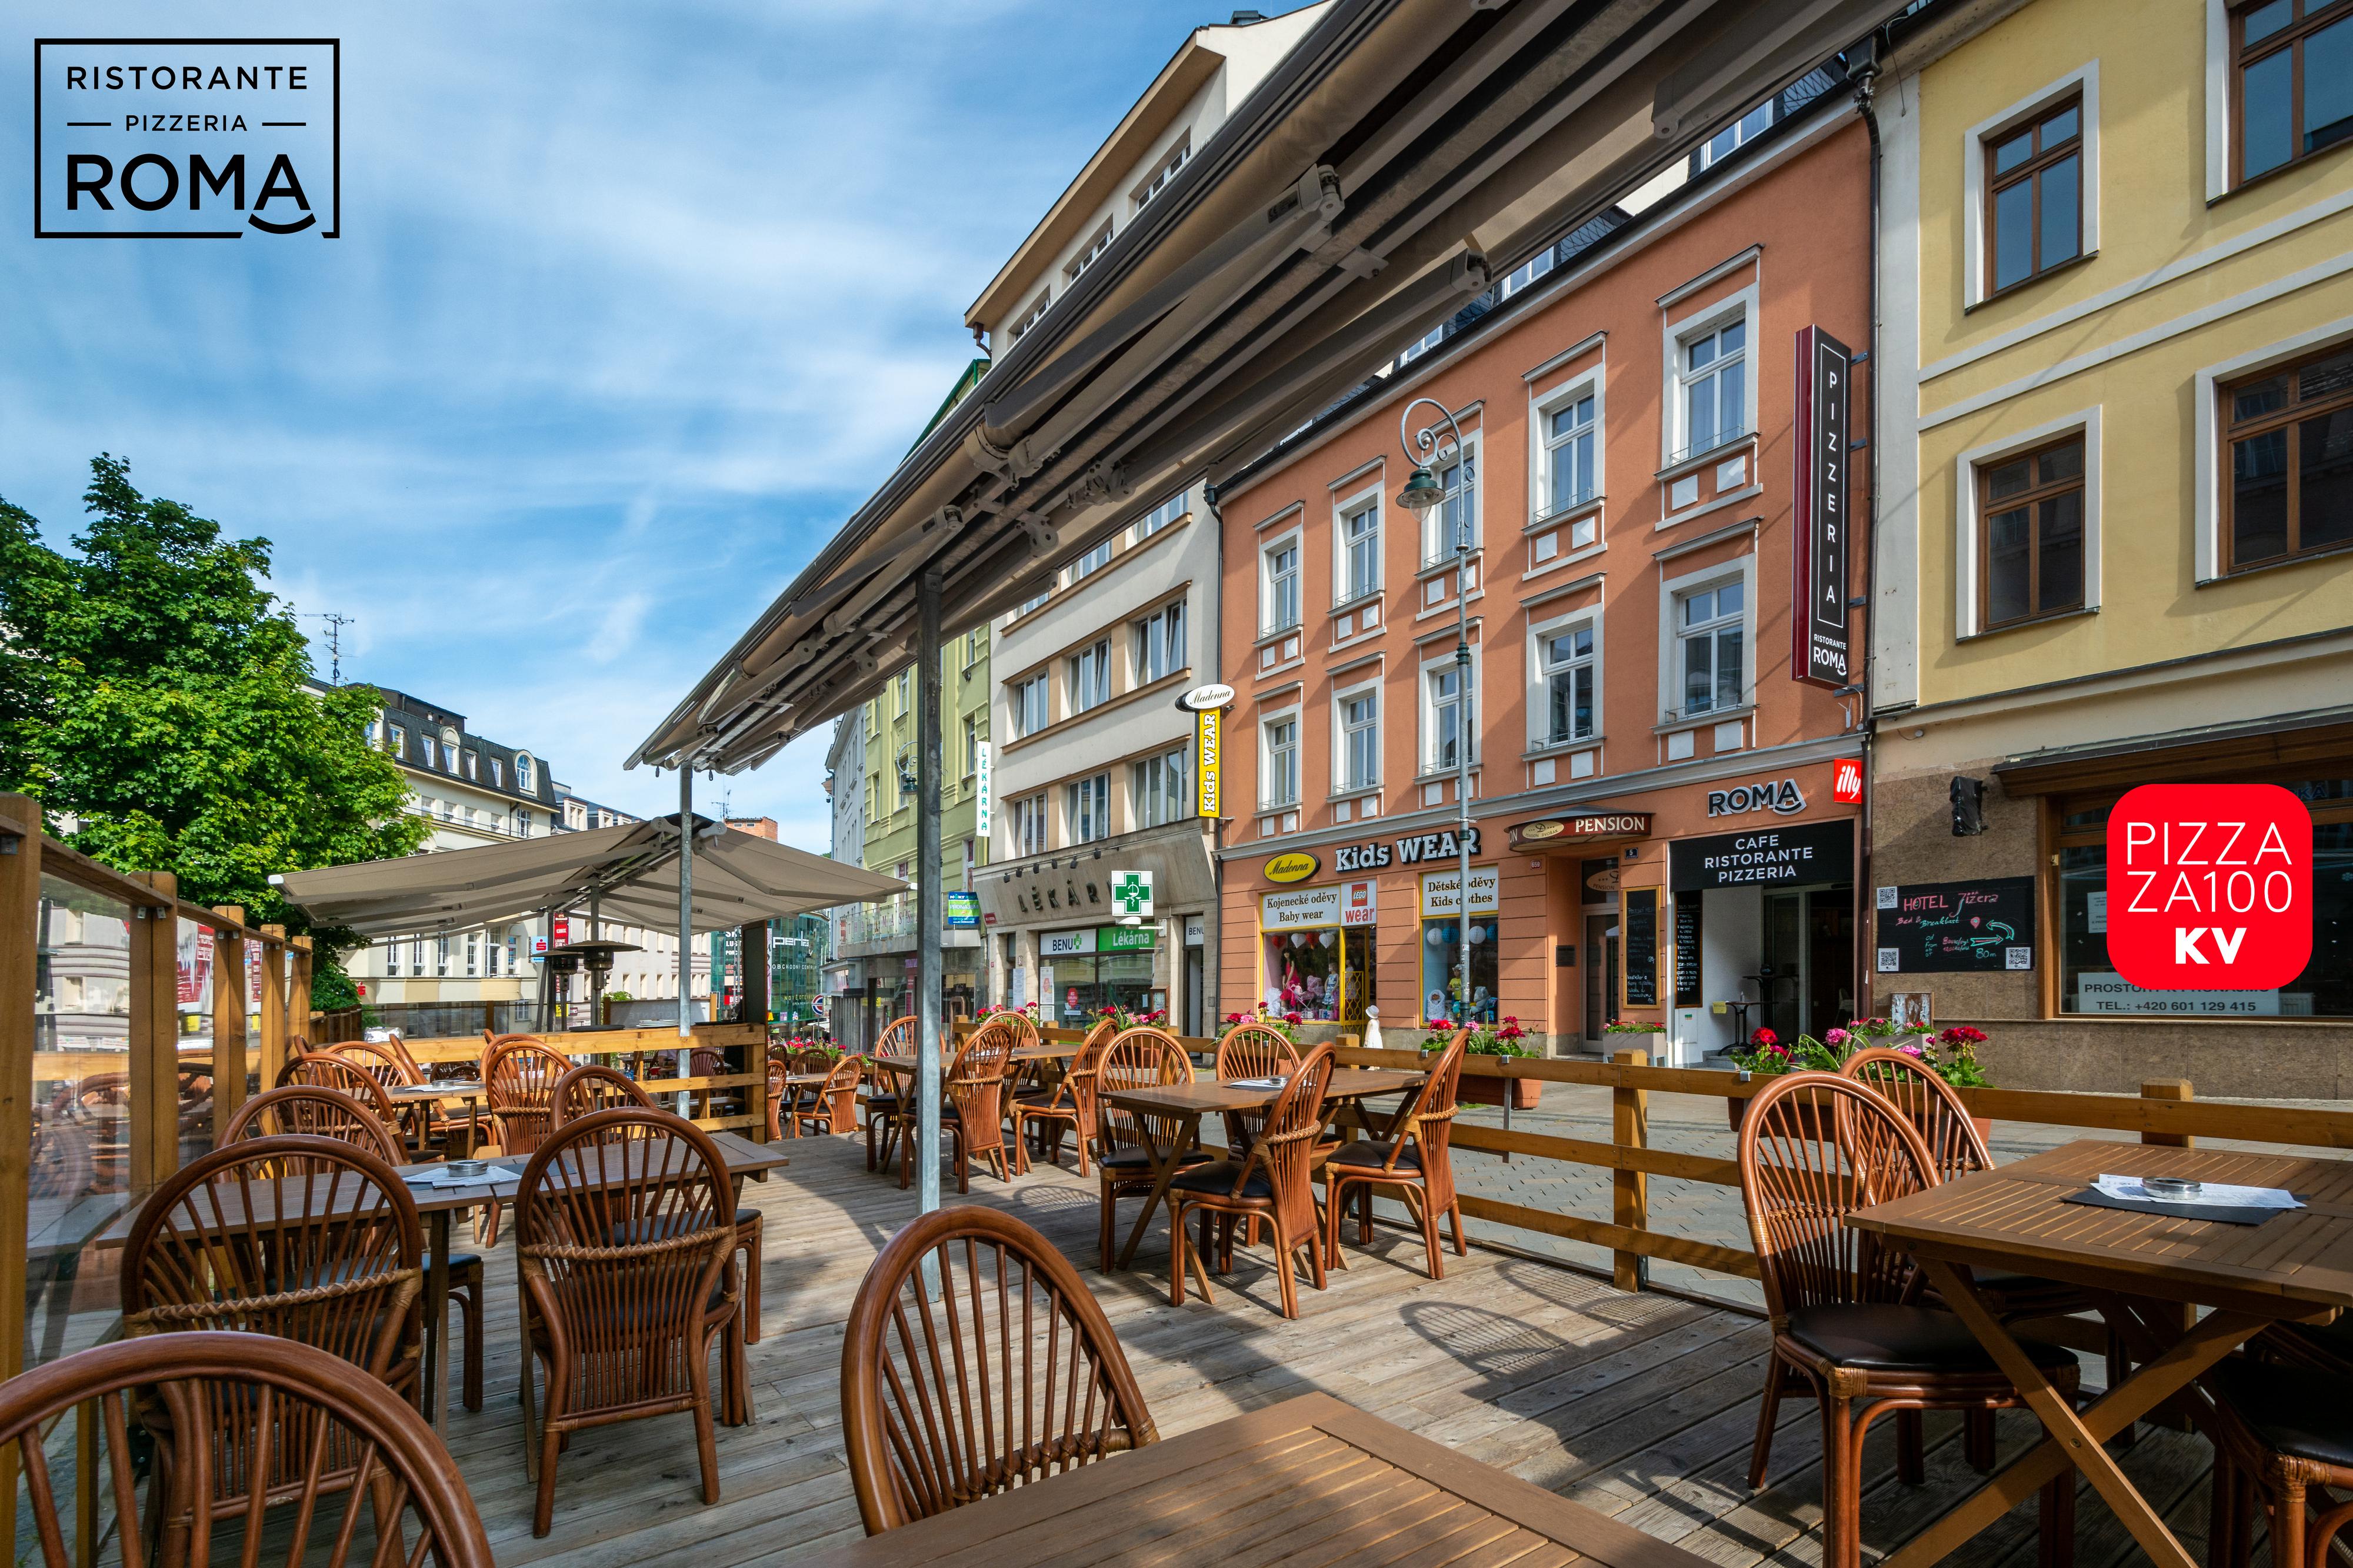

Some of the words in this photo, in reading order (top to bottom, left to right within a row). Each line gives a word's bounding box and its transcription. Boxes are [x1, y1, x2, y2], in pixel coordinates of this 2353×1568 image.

[1825, 371, 1838, 603] PIZZERIA
[1814, 633, 1847, 650] RISTORANTE
[1813, 646, 1847, 673] ROMA
[1190, 689, 1231, 705] Madonna
[1204, 713, 1216, 765] WEAR
[1837, 765, 1861, 799] illy
[1204, 771, 1215, 812] Kids
[1708, 778, 1806, 816] ROMA
[1575, 817, 1645, 833] PENSION
[1336, 843, 1391, 872] Kids
[1397, 829, 1479, 865] WEAR
[1736, 835, 1779, 850] CAFE
[1705, 847, 1813, 869] RISTORANTE
[1269, 860, 1309, 875] Madonna
[1718, 865, 1796, 883] PIZZERIA
[1428, 879, 1461, 892] Dětské
[1468, 877, 1495, 889] děvy
[1267, 894, 1308, 909] Kojenecké
[1311, 892, 1337, 904] oděvy
[1353, 890, 1367, 899] LEGO
[1431, 896, 1453, 906] Kids
[1456, 893, 1492, 905] cthes
[1904, 895, 1949, 912] HOTEL
[1279, 912, 1300, 922] Baby
[1302, 910, 1324, 919] wear
[1345, 908, 1375, 923] wear
[1895, 917, 1913, 926] Bed
[773, 930, 809, 948] perla
[1052, 938, 1073, 951] BENU
[1113, 932, 1149, 946] Lékárna
[2097, 1002, 2130, 1010] TEL.:
[2135, 1002, 2167, 1010] +420
[2171, 1002, 2194, 1010] 601
[2201, 1002, 2225, 1010] 129
[2230, 1002, 2256, 1011] 415
